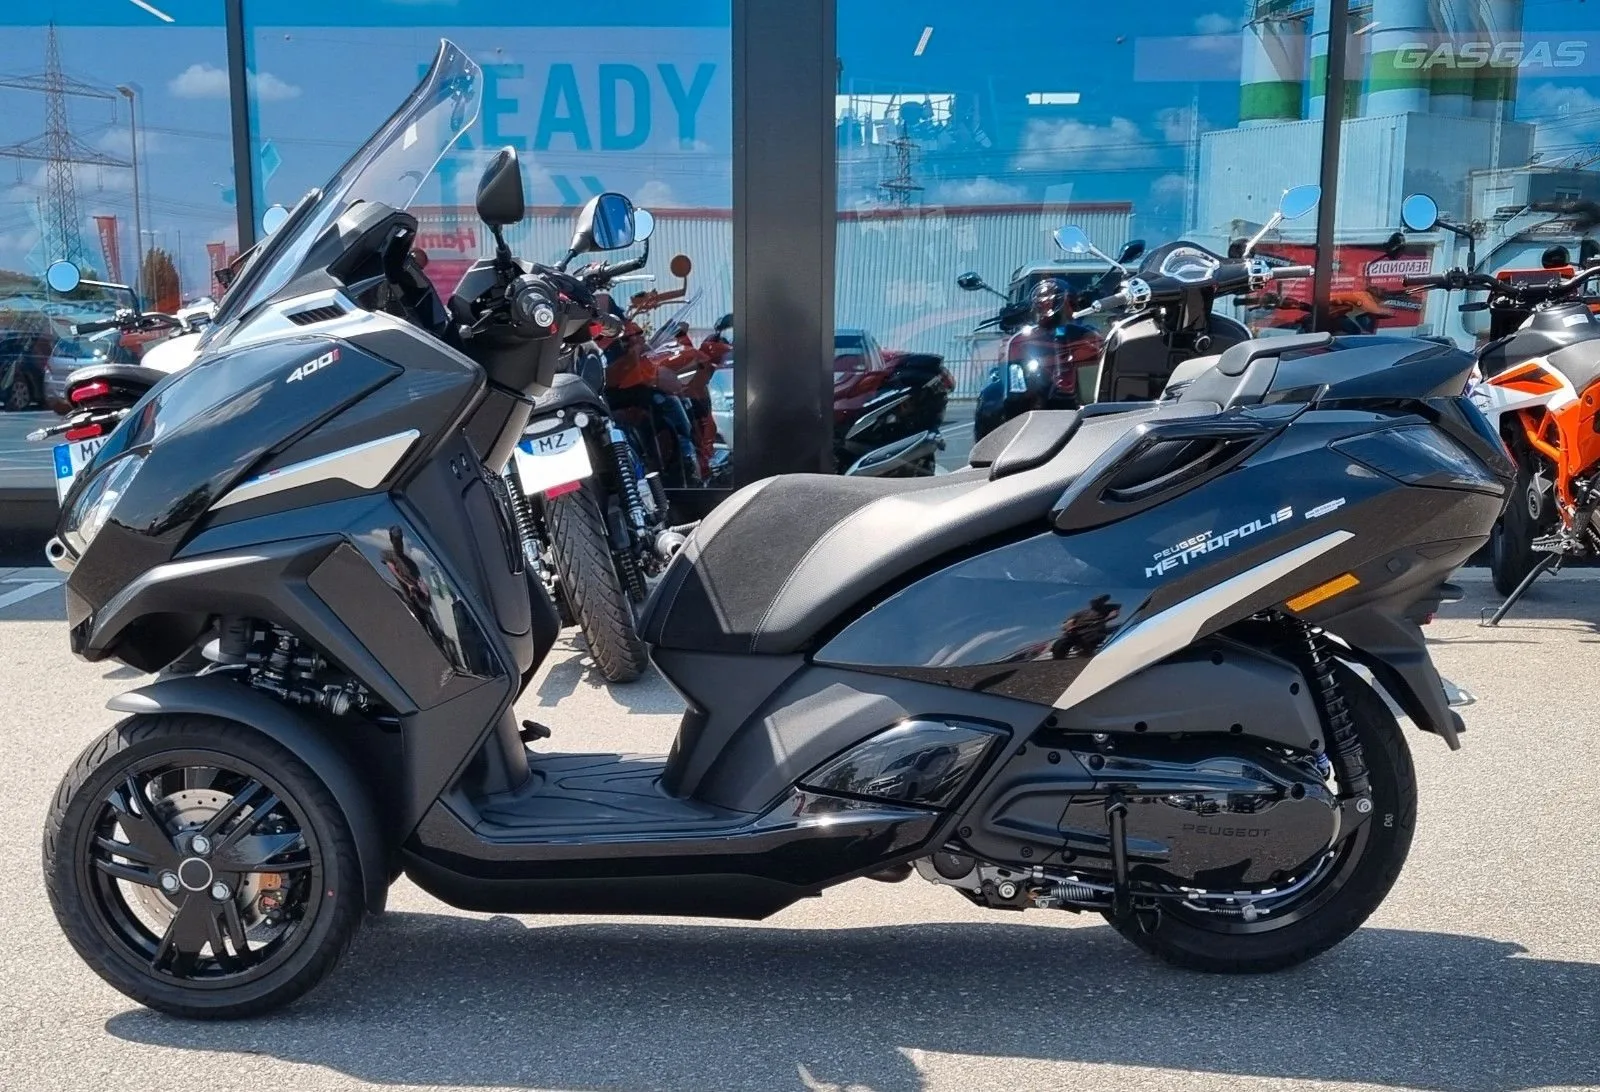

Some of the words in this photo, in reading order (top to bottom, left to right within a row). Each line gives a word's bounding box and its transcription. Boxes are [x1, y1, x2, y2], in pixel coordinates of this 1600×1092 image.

[1393, 40, 1588, 69] GASGAS
[538, 433, 568, 453] MZ
[1145, 505, 1293, 579] METROPOLIS
[1153, 530, 1213, 561] PEUGEOT
[1182, 823, 1271, 838] PEUGEOT
